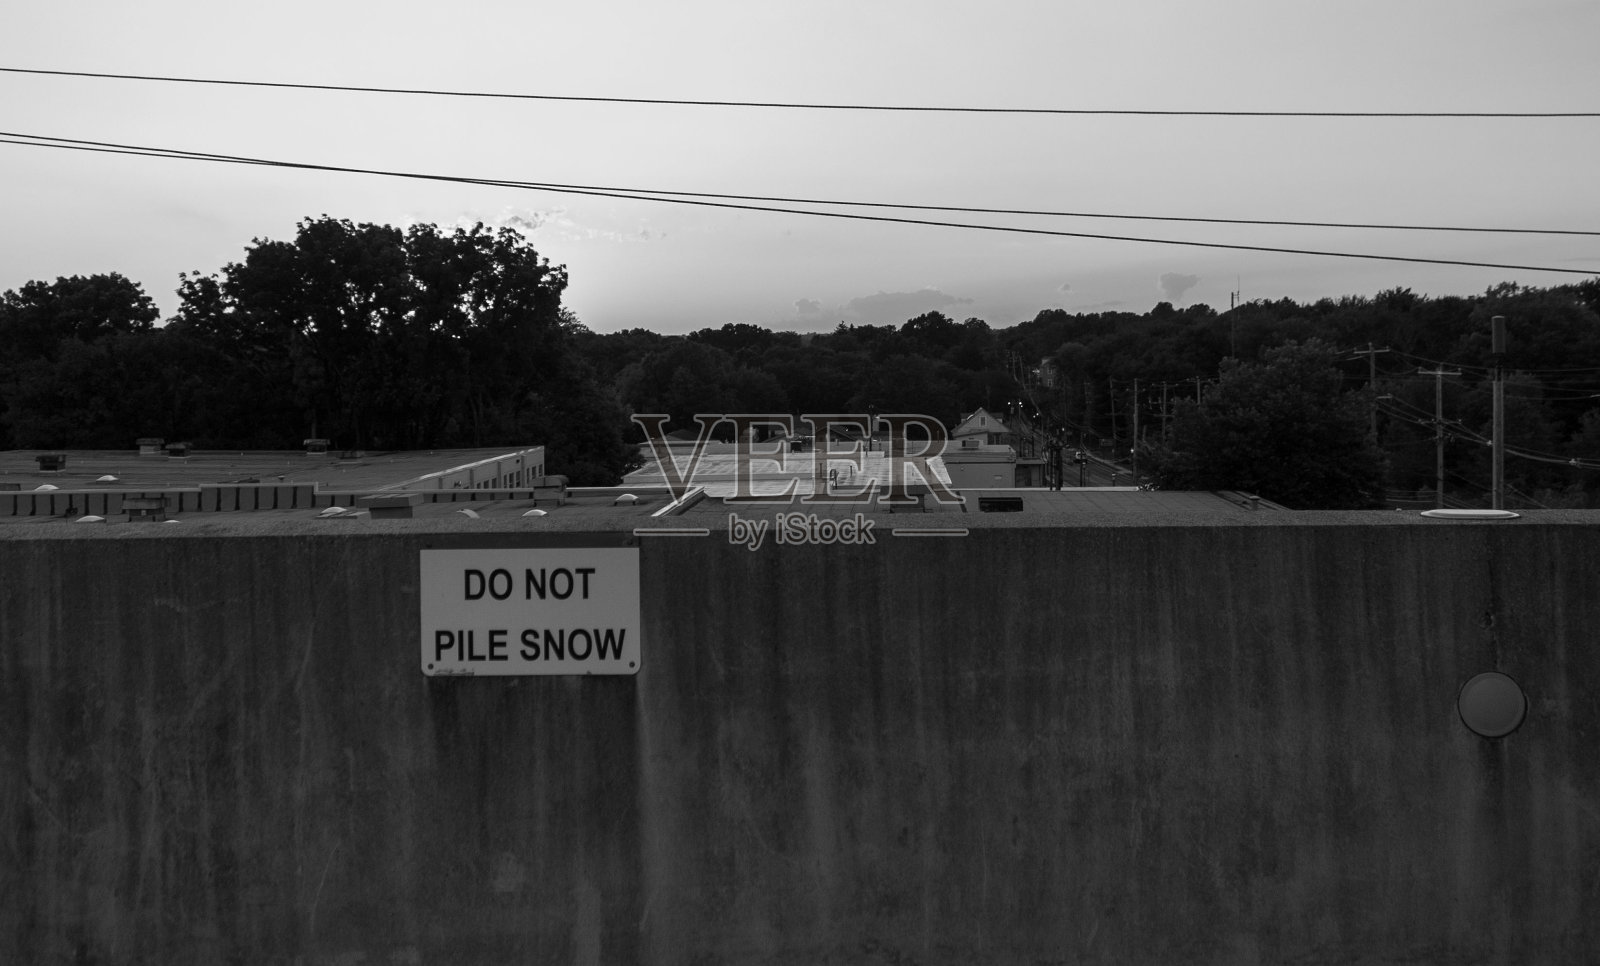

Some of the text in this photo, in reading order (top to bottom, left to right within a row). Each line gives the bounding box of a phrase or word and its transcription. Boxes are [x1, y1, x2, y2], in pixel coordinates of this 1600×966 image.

[464, 567, 596, 601] DO NOT
[435, 628, 626, 661] PILE SNOW
